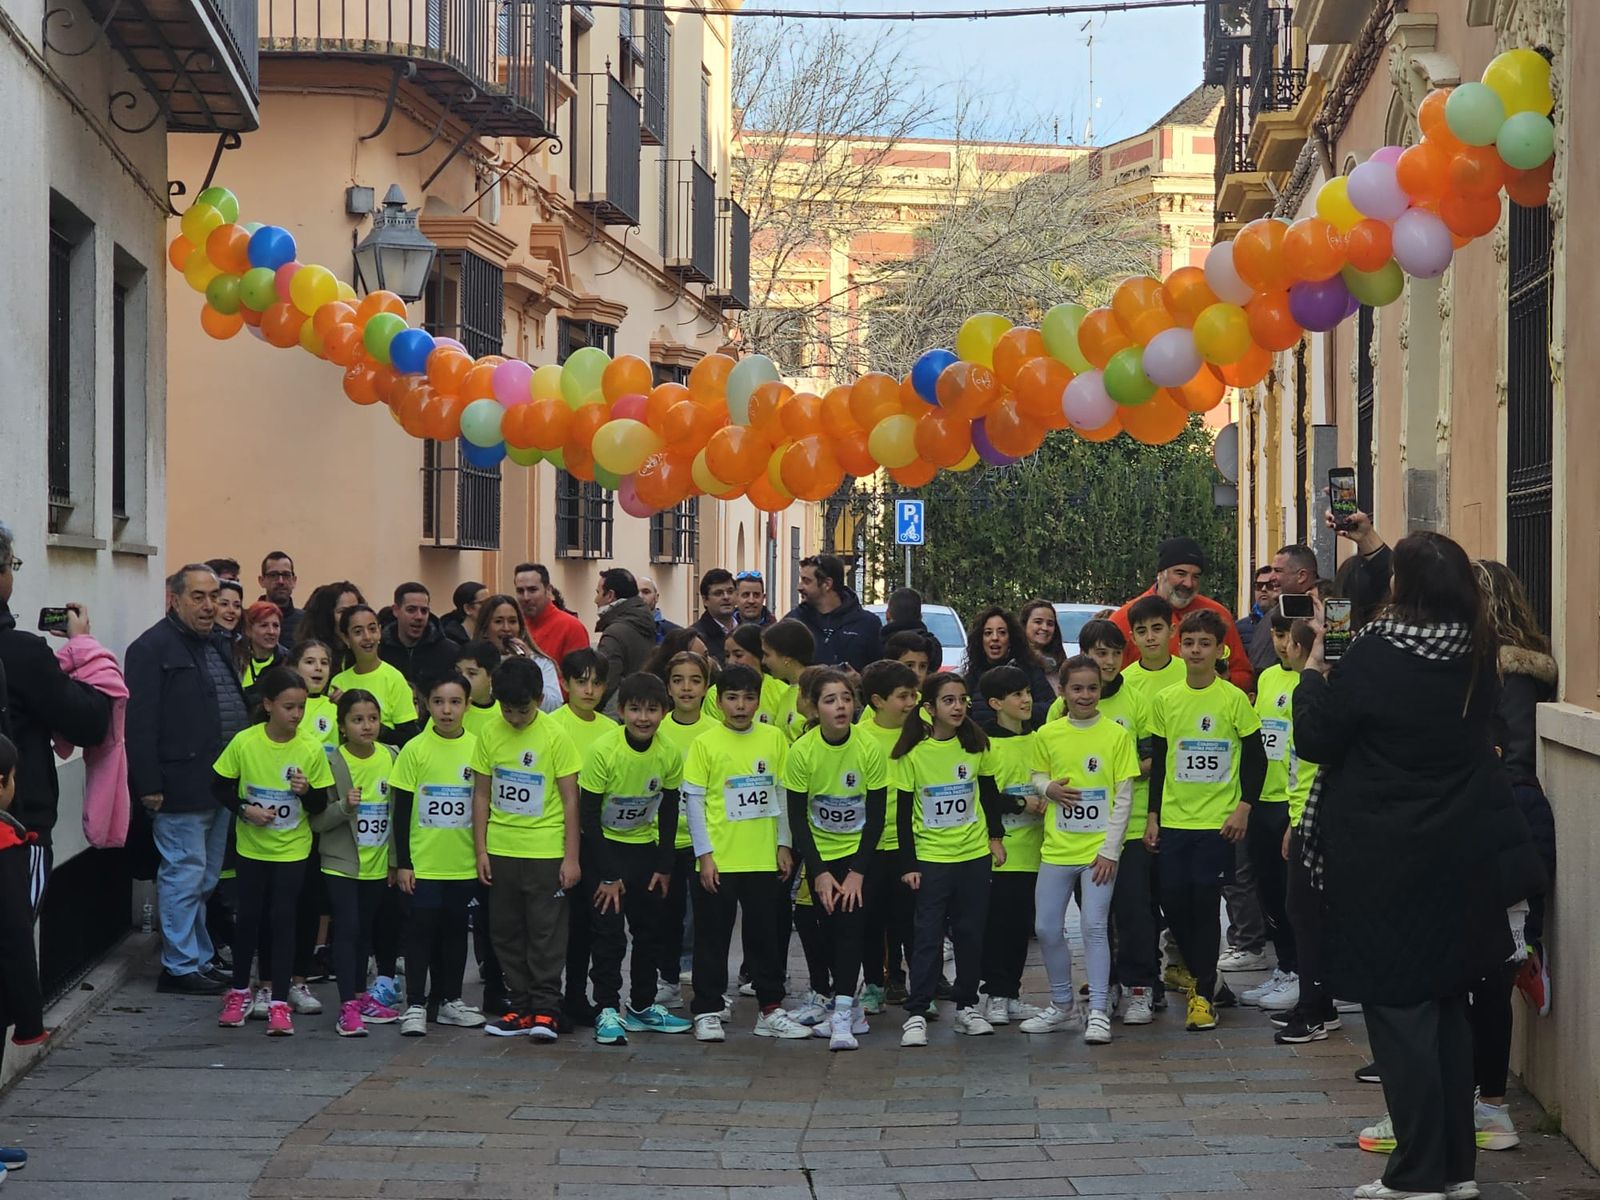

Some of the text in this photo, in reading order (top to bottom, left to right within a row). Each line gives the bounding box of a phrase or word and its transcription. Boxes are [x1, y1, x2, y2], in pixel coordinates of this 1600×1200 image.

[904, 504, 917, 521] P
[1186, 755, 1218, 770] 135
[499, 784, 530, 803] 120
[738, 791, 768, 807] 142
[428, 801, 465, 816] 203
[819, 807, 856, 822] 092
[935, 799, 967, 815] 170
[1063, 805, 1099, 820] 090
[357, 819, 387, 834] 039
